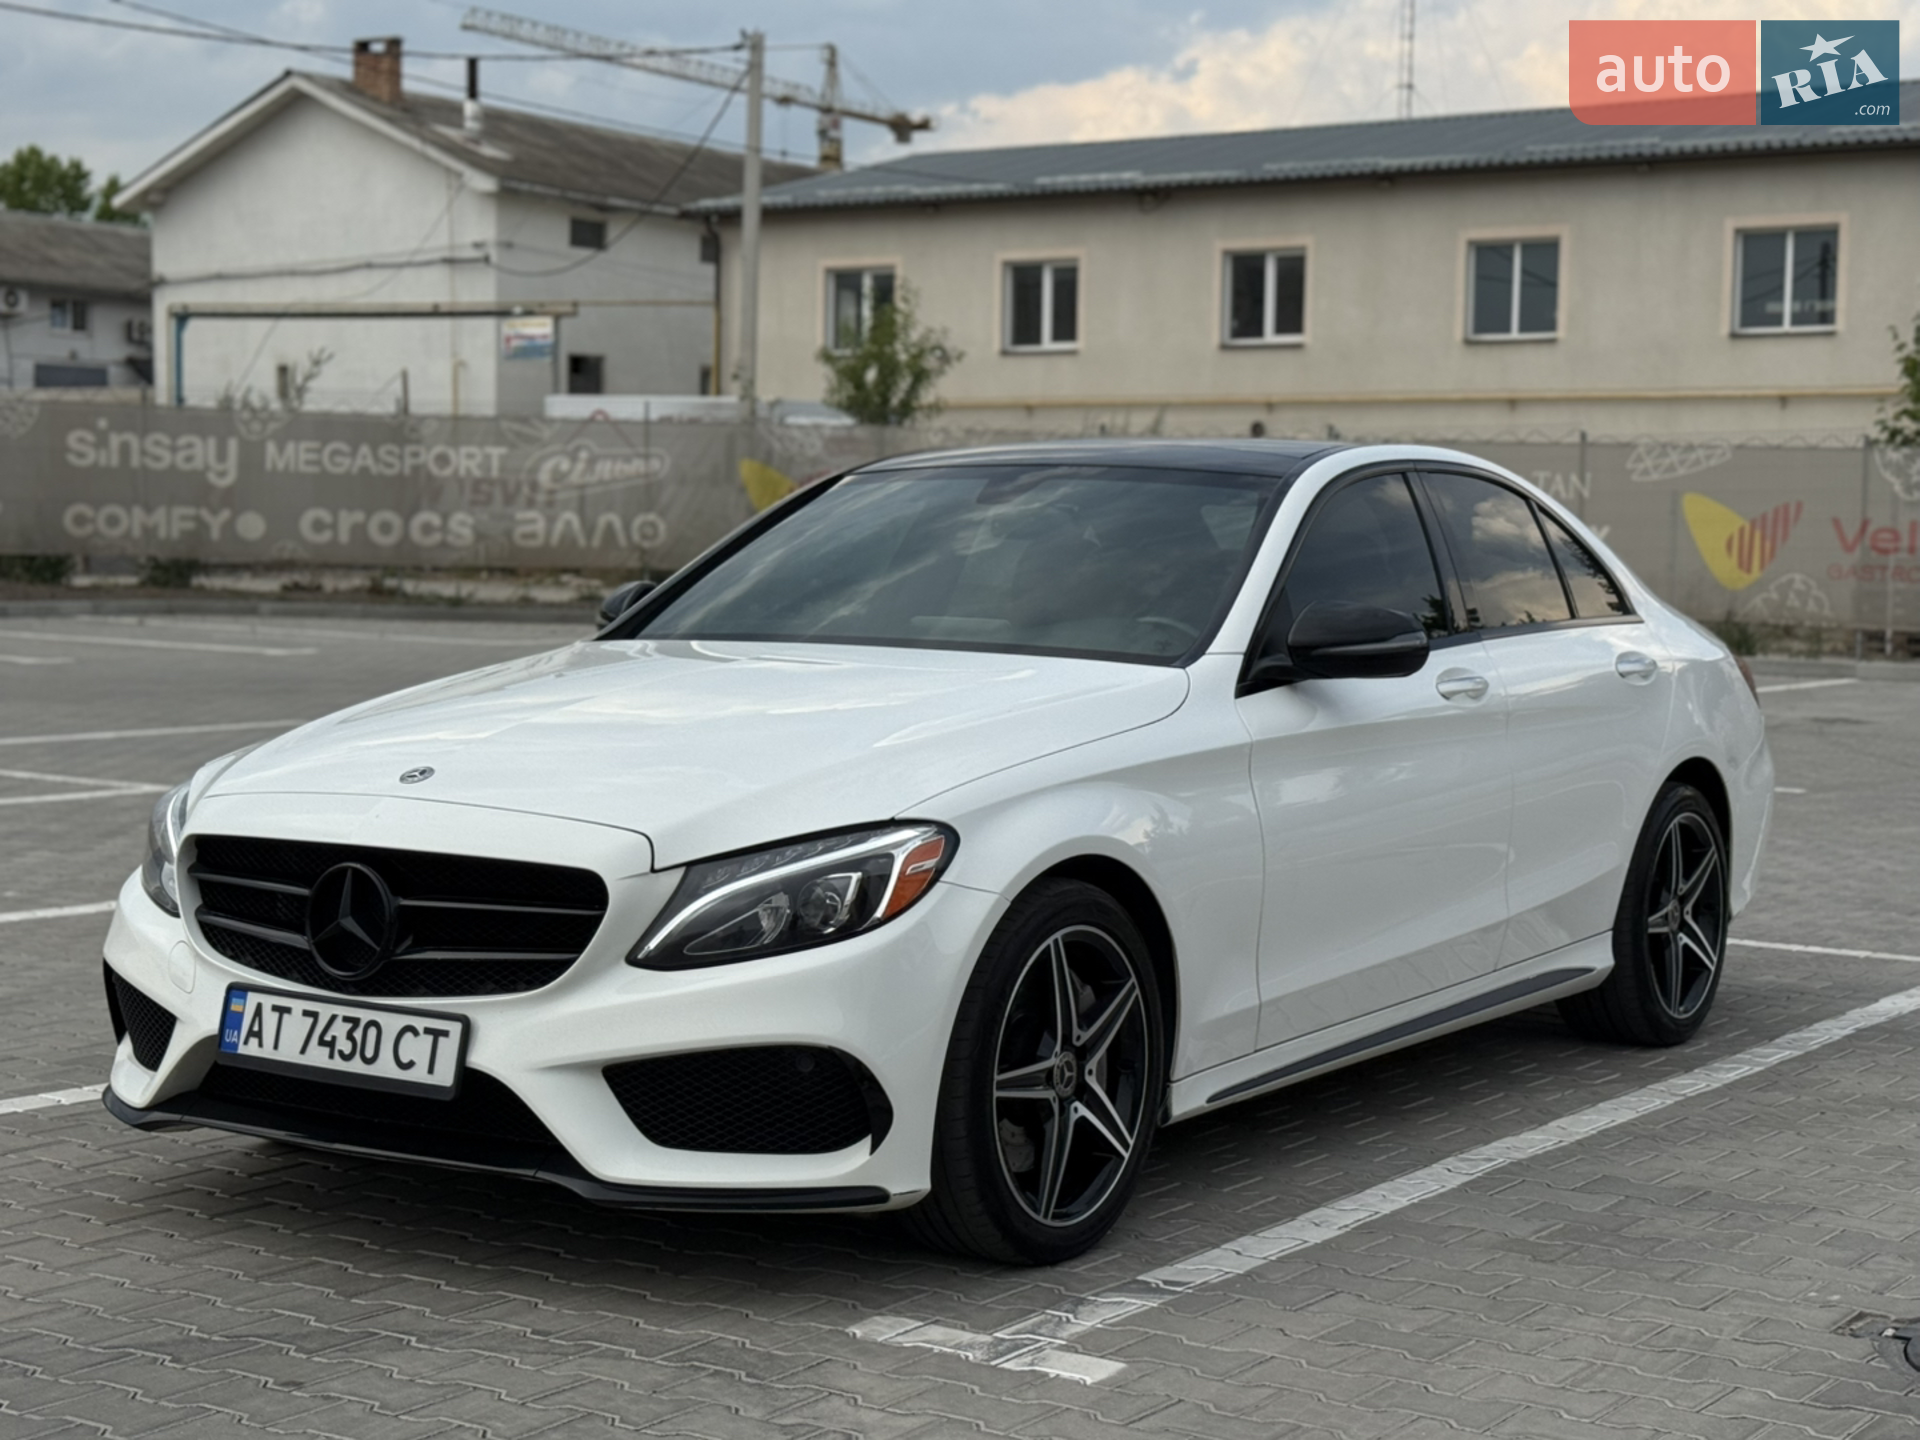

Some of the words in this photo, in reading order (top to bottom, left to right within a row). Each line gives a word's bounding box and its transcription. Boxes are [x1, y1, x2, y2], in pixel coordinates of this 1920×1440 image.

[65, 417, 239, 488] sinsay
[264, 441, 508, 478] MEGASPORT
[62, 503, 232, 541] COMFY
[299, 507, 475, 547] crocs
[224, 1028, 239, 1045] UA
[242, 1001, 293, 1051] AT
[298, 1008, 383, 1066] 7430
[392, 1023, 451, 1076] CT
